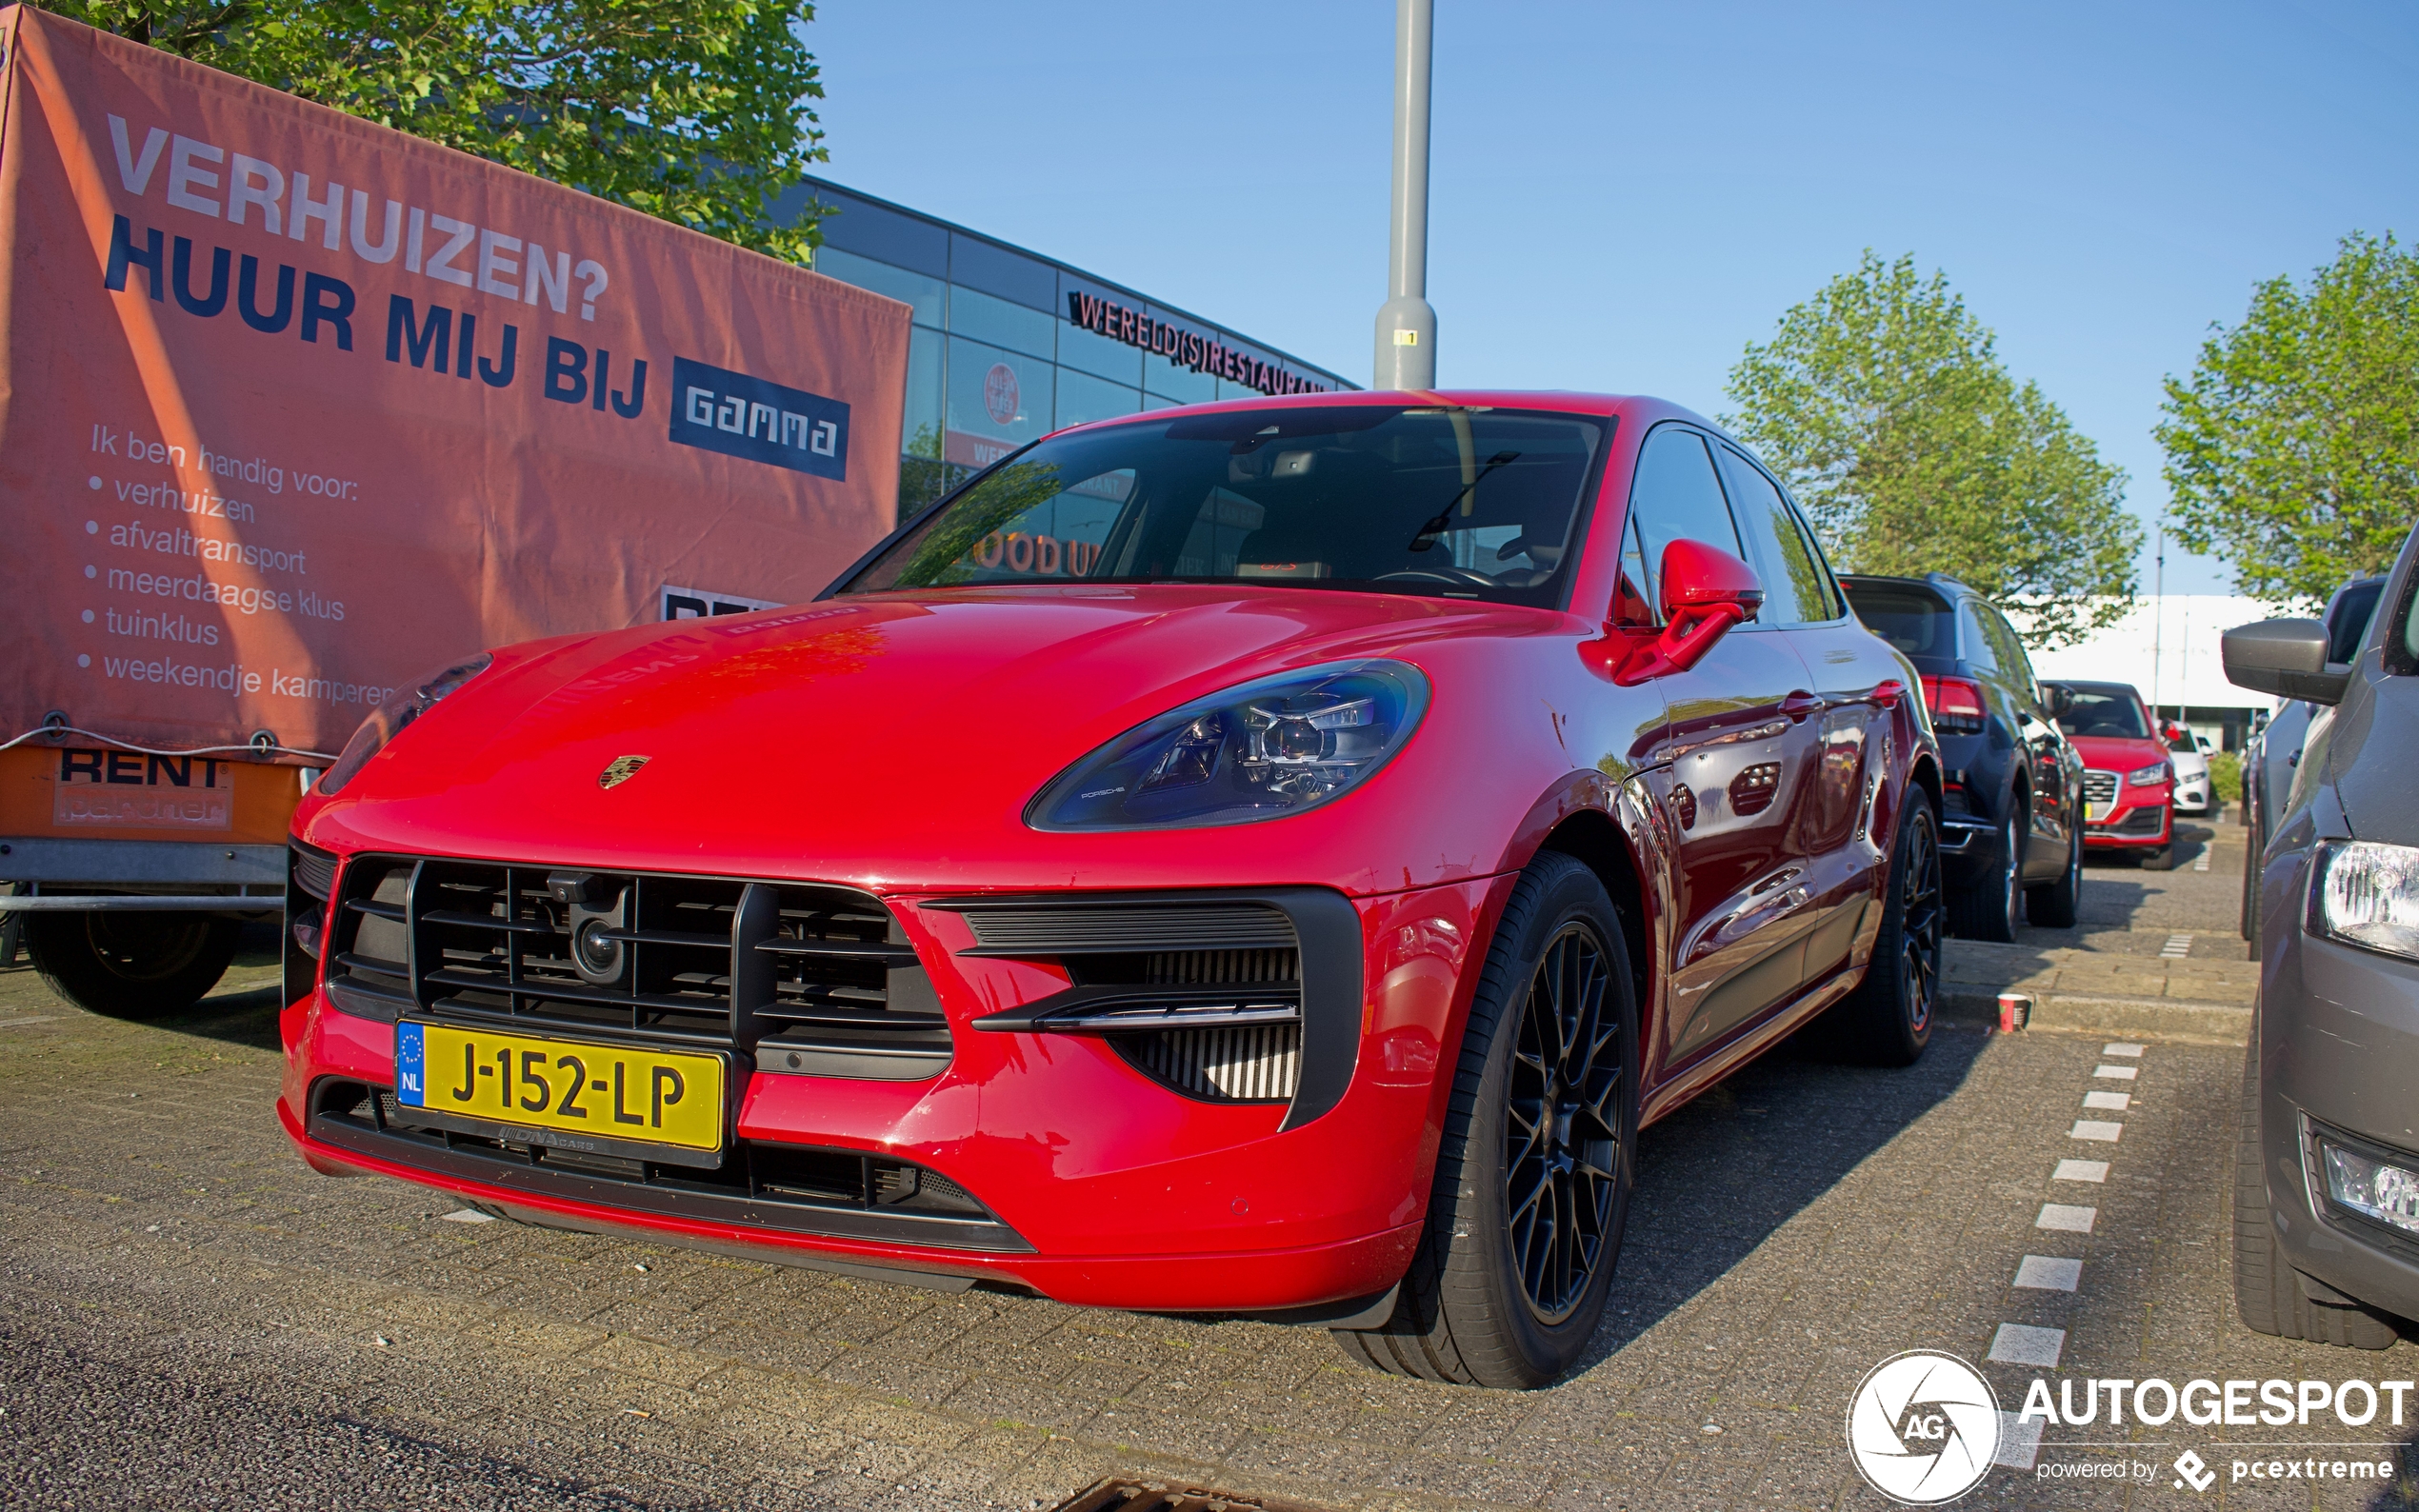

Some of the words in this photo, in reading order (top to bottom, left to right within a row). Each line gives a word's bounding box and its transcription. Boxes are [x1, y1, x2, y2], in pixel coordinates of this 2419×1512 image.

[107, 112, 609, 322] VERHUIZEN?
[104, 213, 354, 352] HUUR
[386, 293, 518, 388] MIJ
[544, 335, 648, 419] BIJ
[91, 424, 118, 457] Ik
[128, 431, 186, 468] ben
[197, 445, 284, 494] handig
[292, 470, 358, 502] voor:
[114, 479, 255, 524] verhuizen
[110, 520, 306, 575] afvaltransport
[108, 567, 292, 615] meerdaagse
[298, 588, 345, 621] klus
[106, 607, 220, 646] tuinklus
[104, 655, 262, 698] weekendje
[61, 748, 217, 788] RENT
[1081, 786, 1125, 799] PORSCHE
[1685, 1010, 1711, 1042] GTS
[402, 1072, 422, 1093] NL
[452, 1044, 686, 1128] J-152-LP
[558, 1139, 595, 1151] CARS
